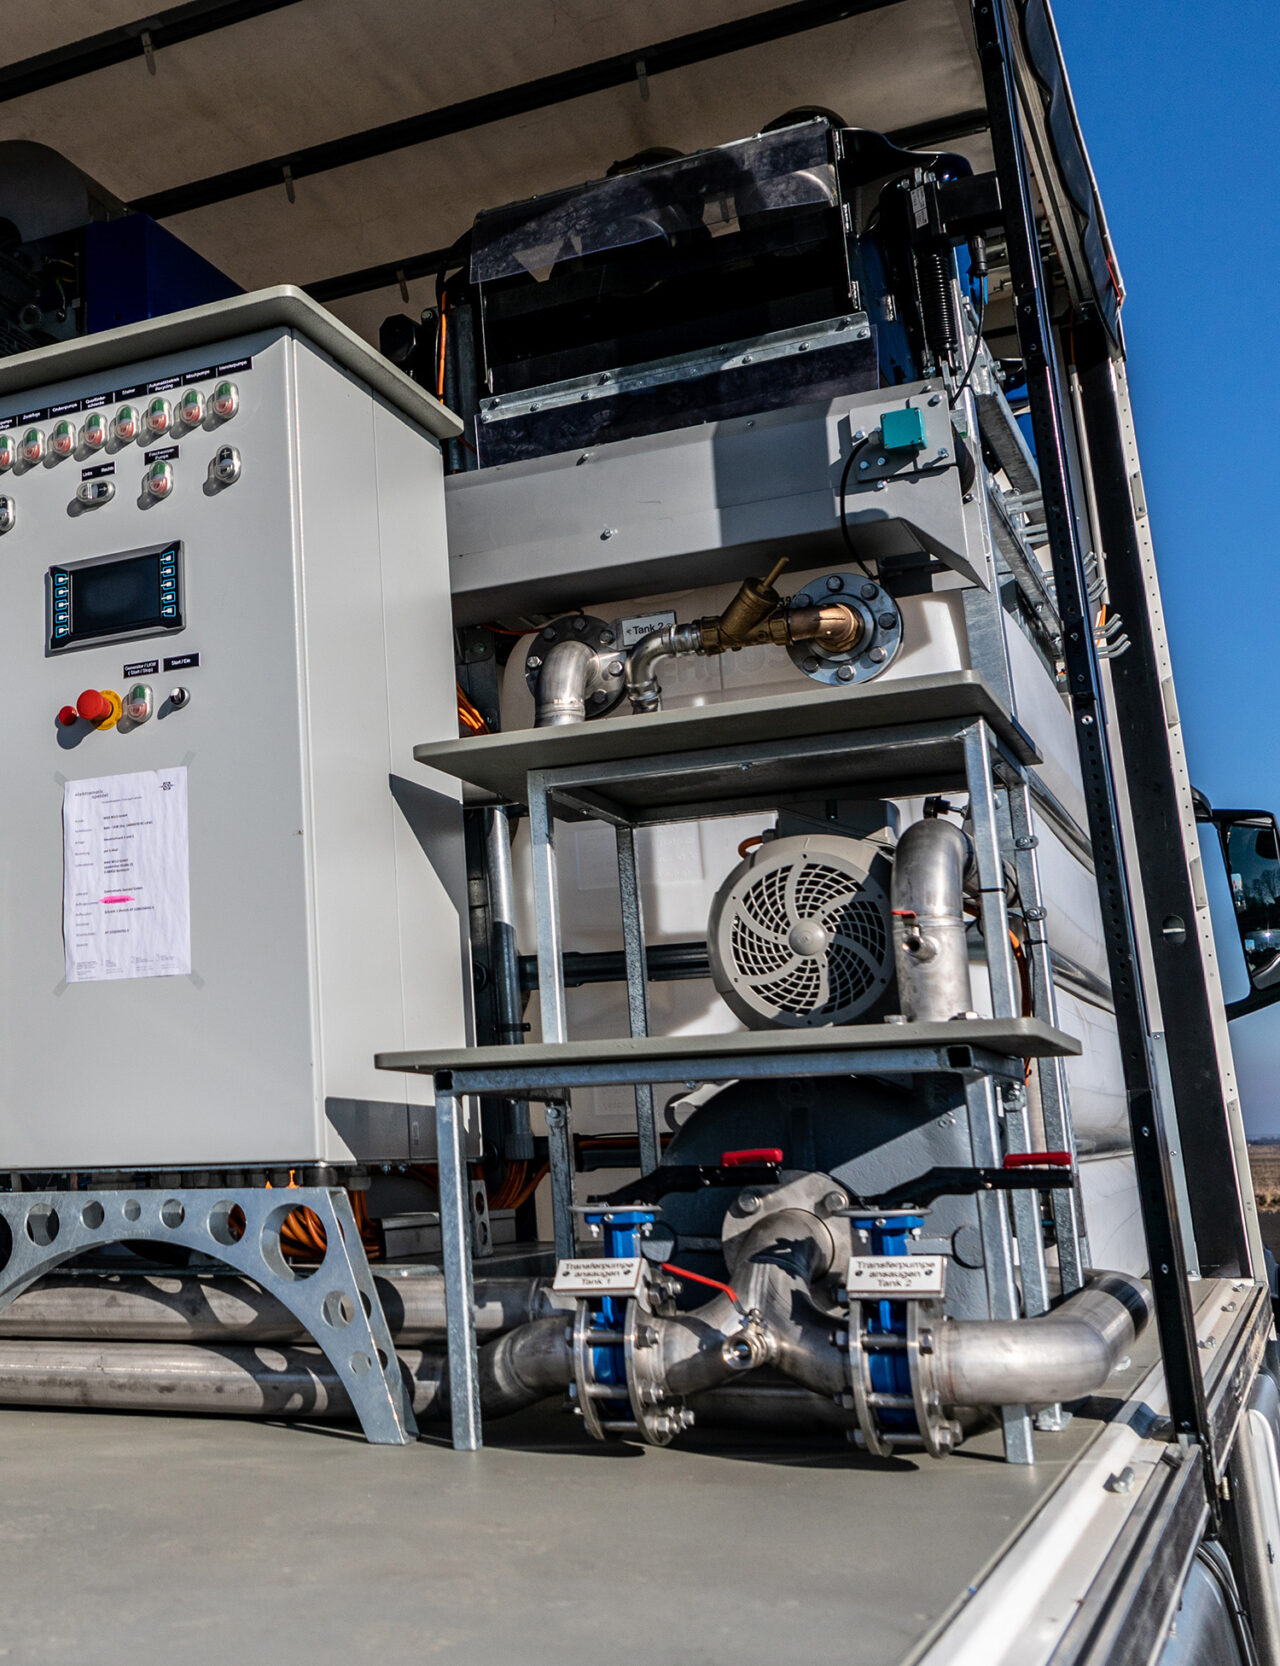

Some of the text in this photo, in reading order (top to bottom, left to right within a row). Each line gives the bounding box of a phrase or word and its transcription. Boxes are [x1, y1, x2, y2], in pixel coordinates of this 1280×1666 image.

[632, 624, 655, 635] Tank
[857, 1261, 935, 1269] Transferpumpe
[905, 1279, 912, 1287] 2
